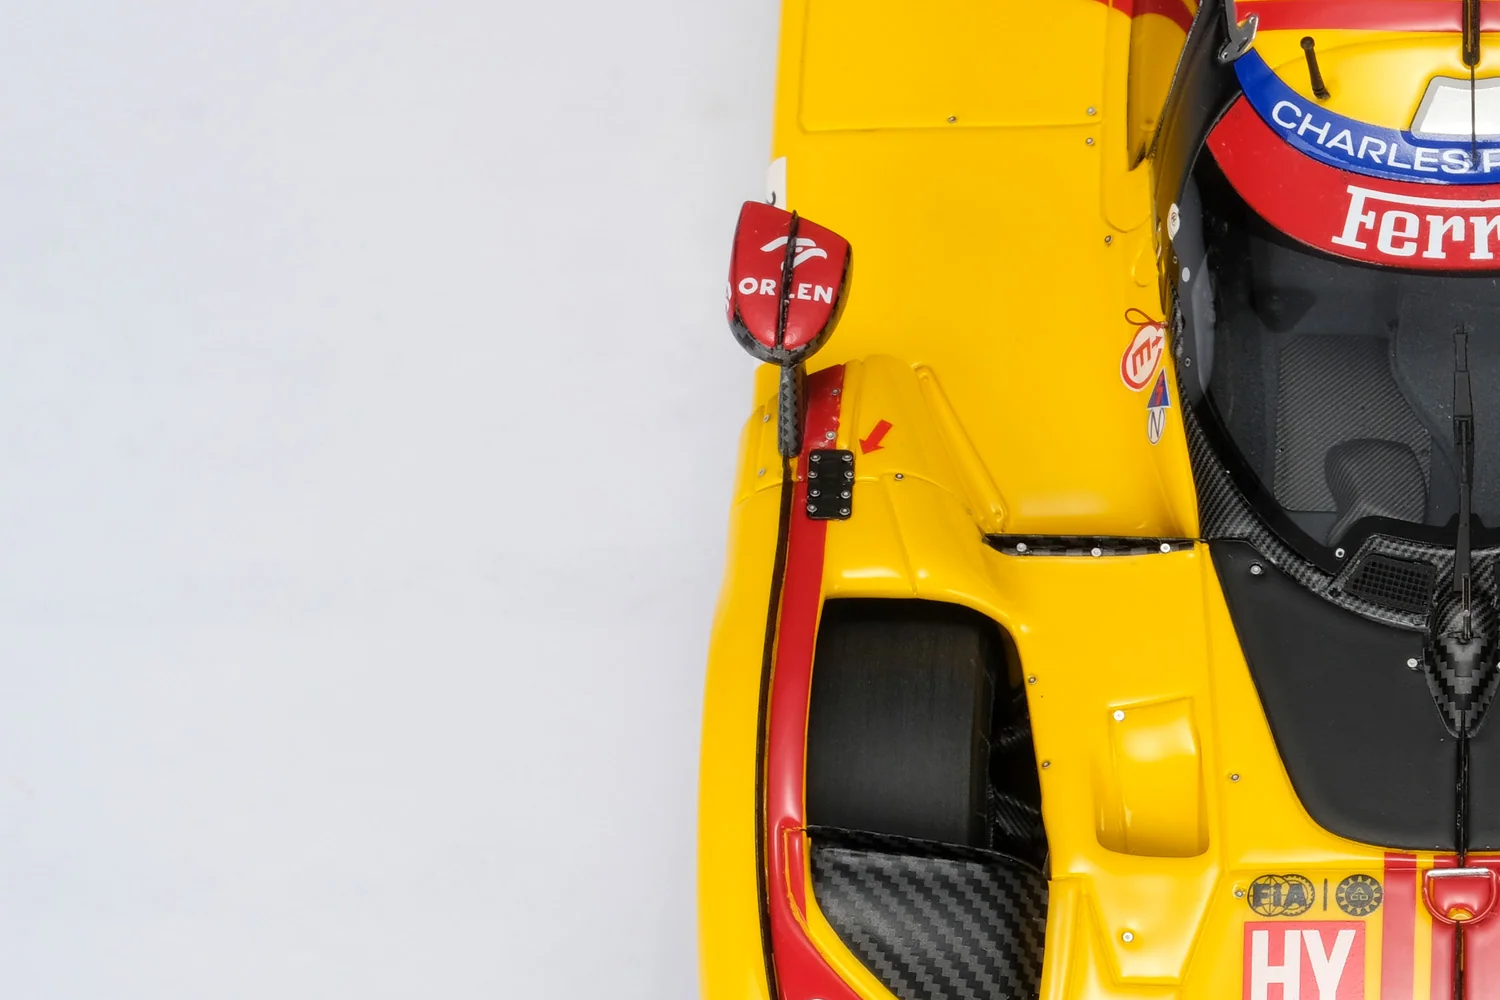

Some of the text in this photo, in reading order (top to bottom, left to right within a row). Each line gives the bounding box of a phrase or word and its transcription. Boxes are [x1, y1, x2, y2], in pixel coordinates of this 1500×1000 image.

[1271, 100, 1470, 174] CHARLES
[738, 277, 834, 304] OREN
[1150, 407, 1164, 439] N
[1252, 882, 1307, 908] FIA
